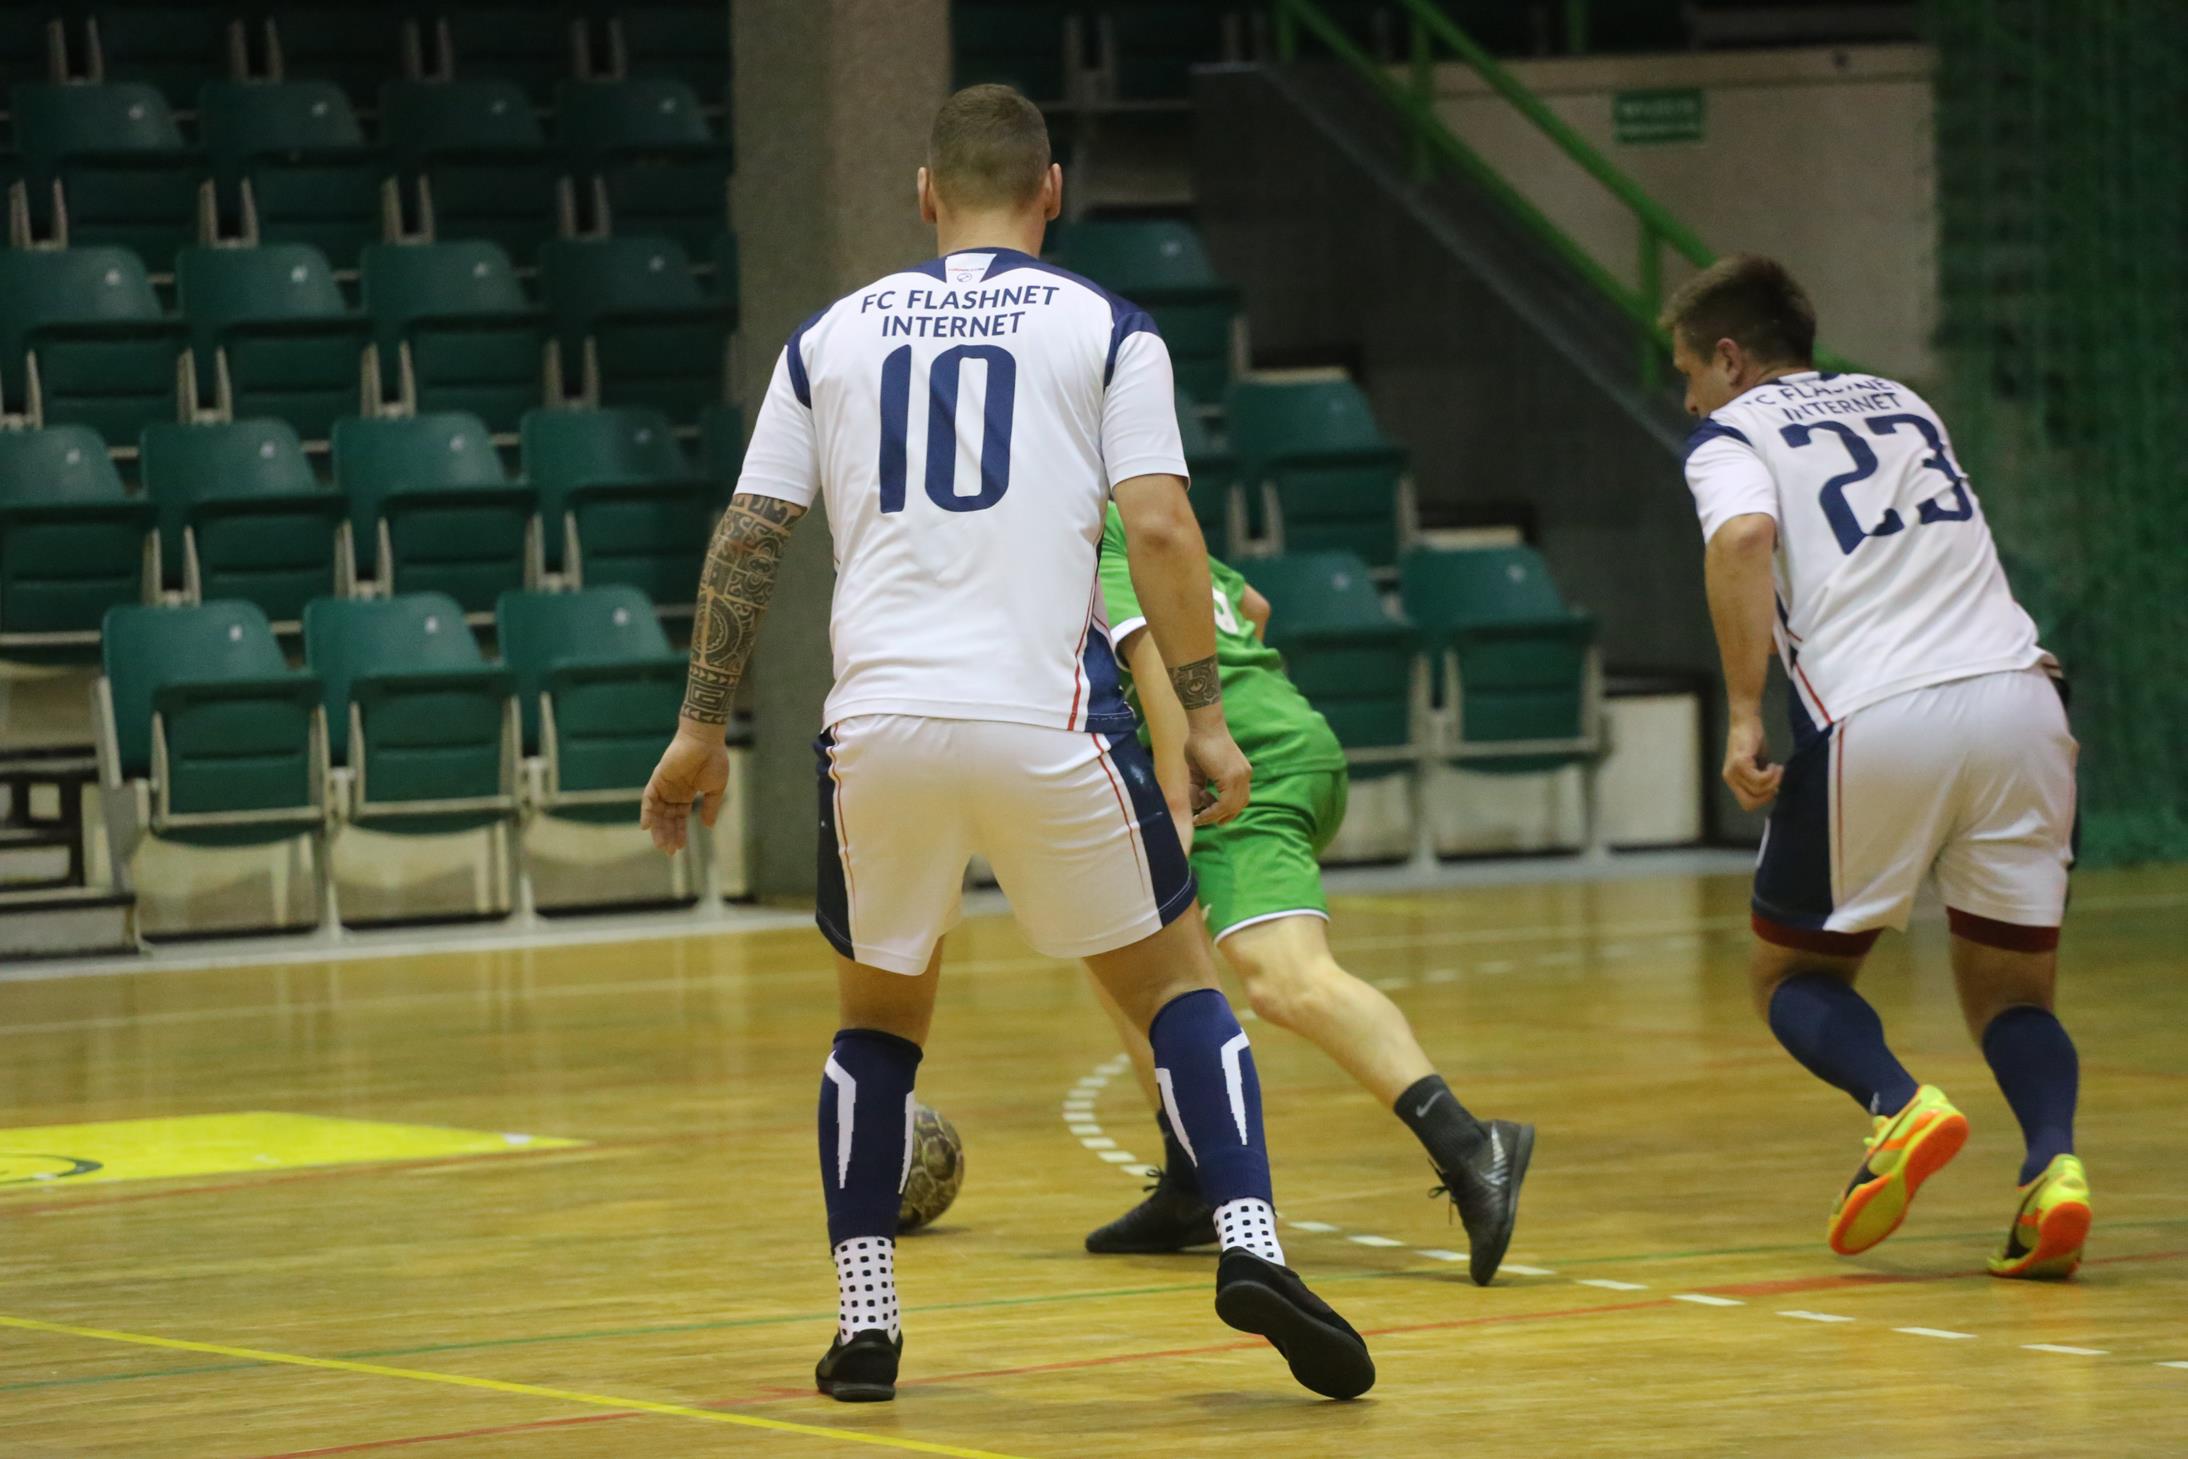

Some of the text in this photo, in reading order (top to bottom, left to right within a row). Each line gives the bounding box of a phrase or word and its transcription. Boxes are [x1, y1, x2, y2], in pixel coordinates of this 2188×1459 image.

[860, 285, 1061, 314] FC FLASHNET
[881, 311, 1027, 338] INTERNET
[1781, 391, 1903, 422] INTERNET
[879, 344, 1017, 514] 10
[1778, 412, 1973, 556] 23
